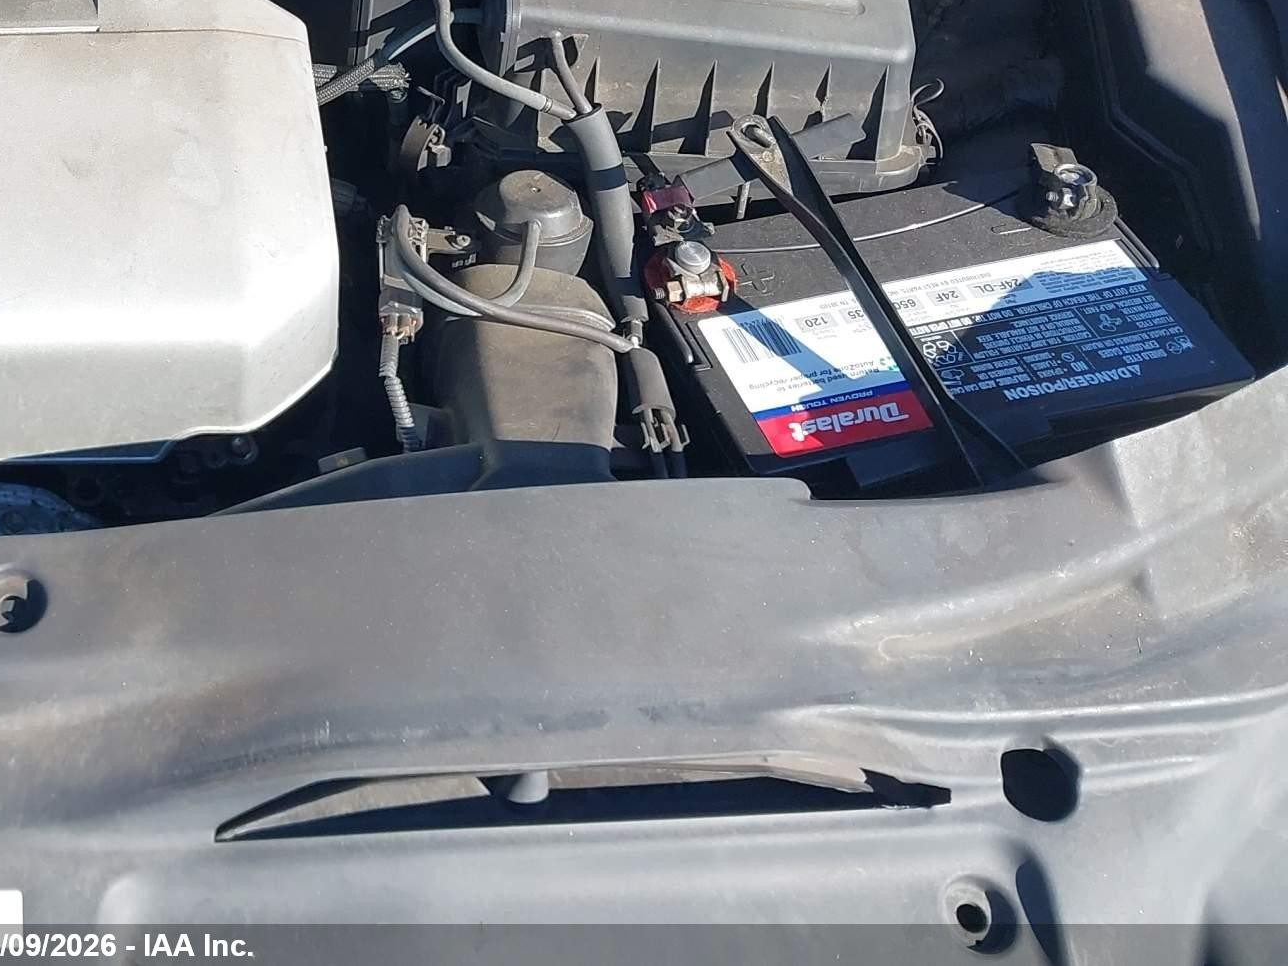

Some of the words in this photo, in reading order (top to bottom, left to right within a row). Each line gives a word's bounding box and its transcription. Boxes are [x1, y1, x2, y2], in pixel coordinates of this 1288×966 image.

[972, 277, 1022, 294] 24F-DL
[1109, 286, 1129, 296] OUT
[1125, 283, 1147, 293] KEEP
[931, 290, 960, 302] 24F
[1060, 294, 1088, 306] REACH
[1083, 291, 1102, 301] THE
[803, 316, 828, 327] 120
[983, 311, 1003, 321] NOT
[1122, 353, 1143, 363] EYES
[817, 368, 833, 376] for
[832, 359, 876, 373] AutoZone
[849, 366, 879, 377] Return
[1069, 360, 1089, 372] NO
[784, 371, 819, 383] proper
[826, 372, 848, 381] used
[746, 377, 786, 390] recycling
[786, 377, 826, 389] batteries
[1001, 365, 1132, 401] DANGER/POISON
[828, 389, 873, 403] PROVEN
[789, 399, 827, 411] TOUGH
[784, 401, 911, 442] Duralast
